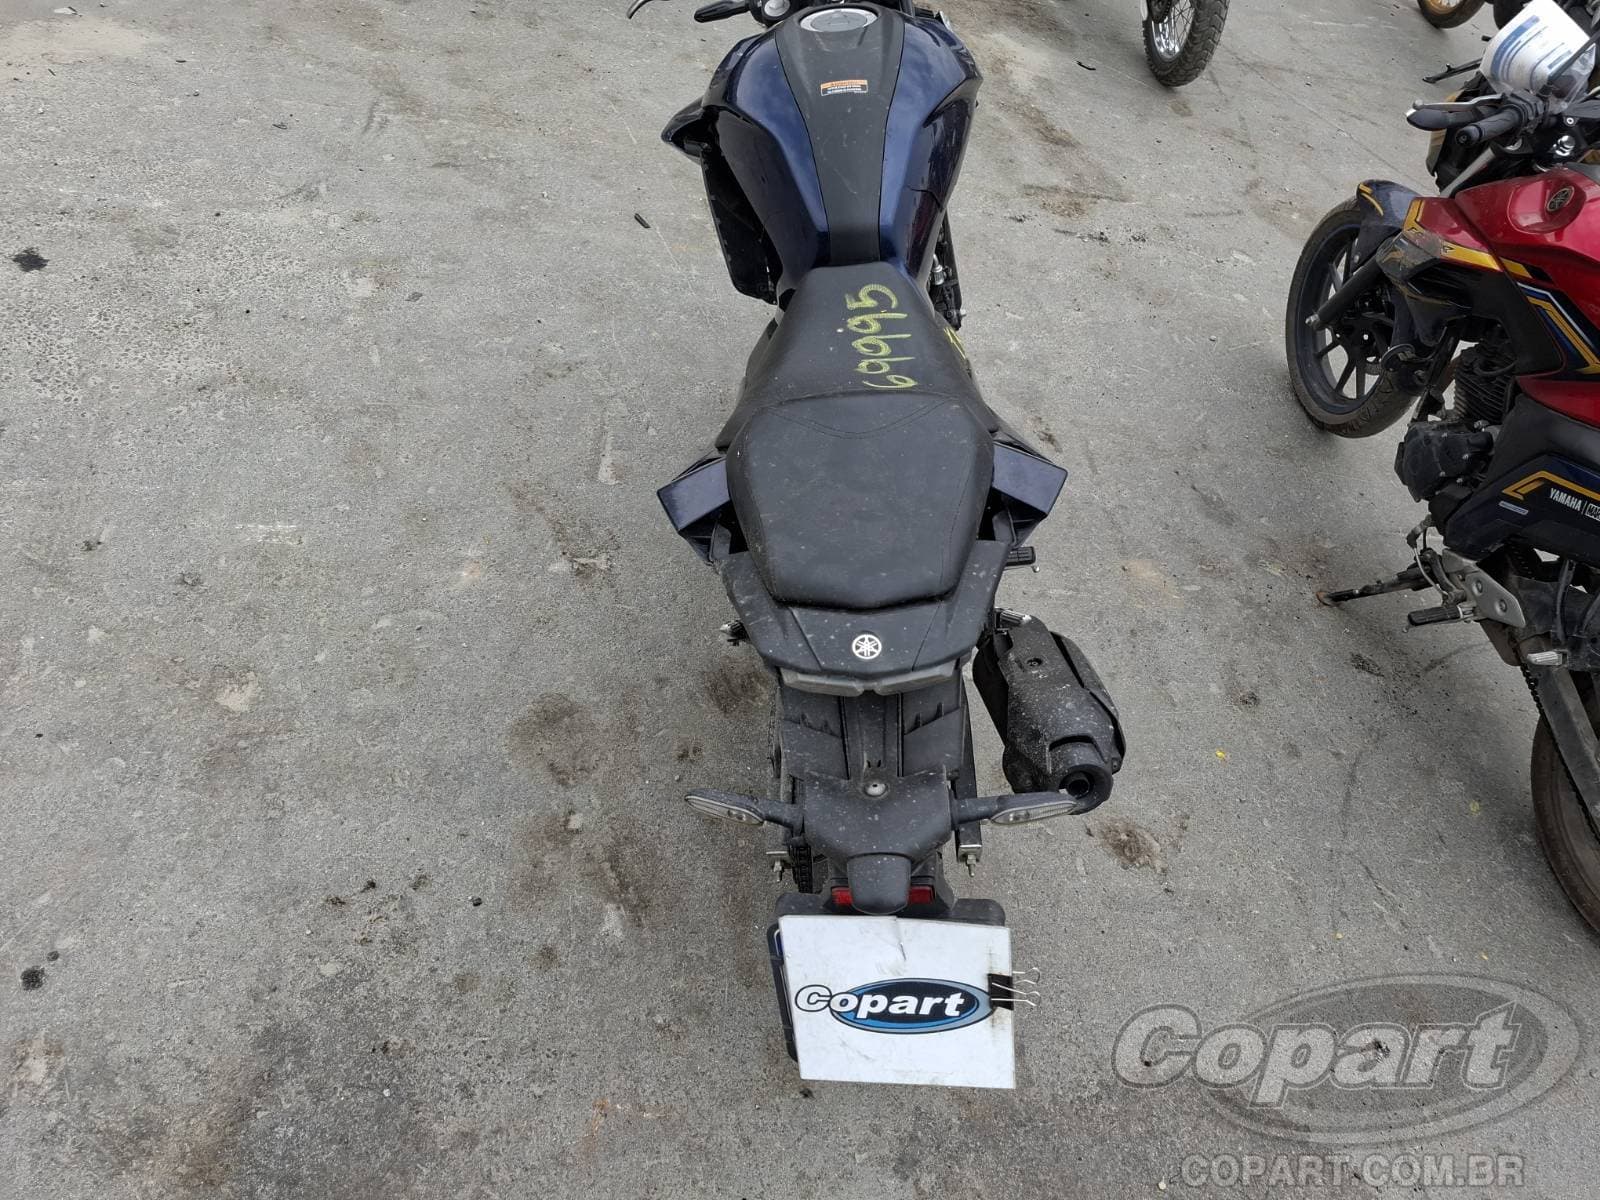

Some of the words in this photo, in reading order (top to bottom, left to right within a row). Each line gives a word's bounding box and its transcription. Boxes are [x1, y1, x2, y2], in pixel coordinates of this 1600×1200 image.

[845, 284, 918, 389] 69995
[1549, 487, 1582, 511] YAMAHA
[795, 984, 965, 1019] Copart
